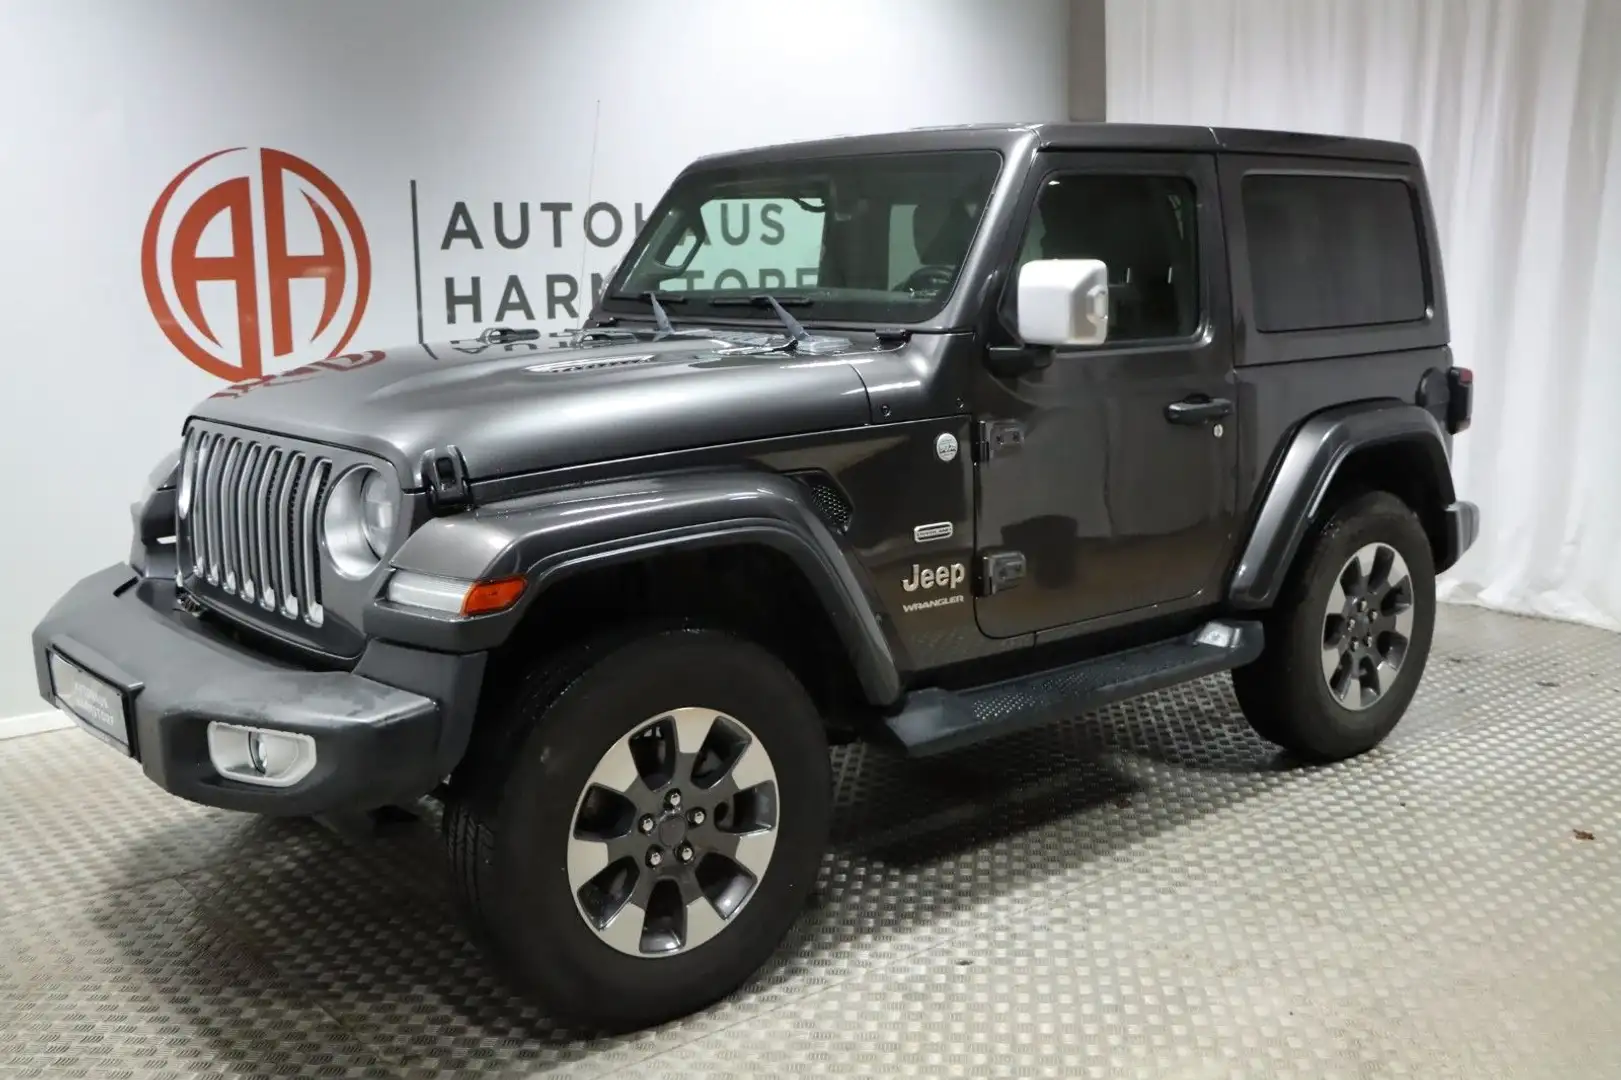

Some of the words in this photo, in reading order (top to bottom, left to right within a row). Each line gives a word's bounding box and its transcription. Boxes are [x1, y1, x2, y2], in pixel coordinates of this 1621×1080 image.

[441, 201, 786, 250] AUTOUS
[902, 562, 966, 592] Jeep
[902, 594, 965, 613] WRANGLER
